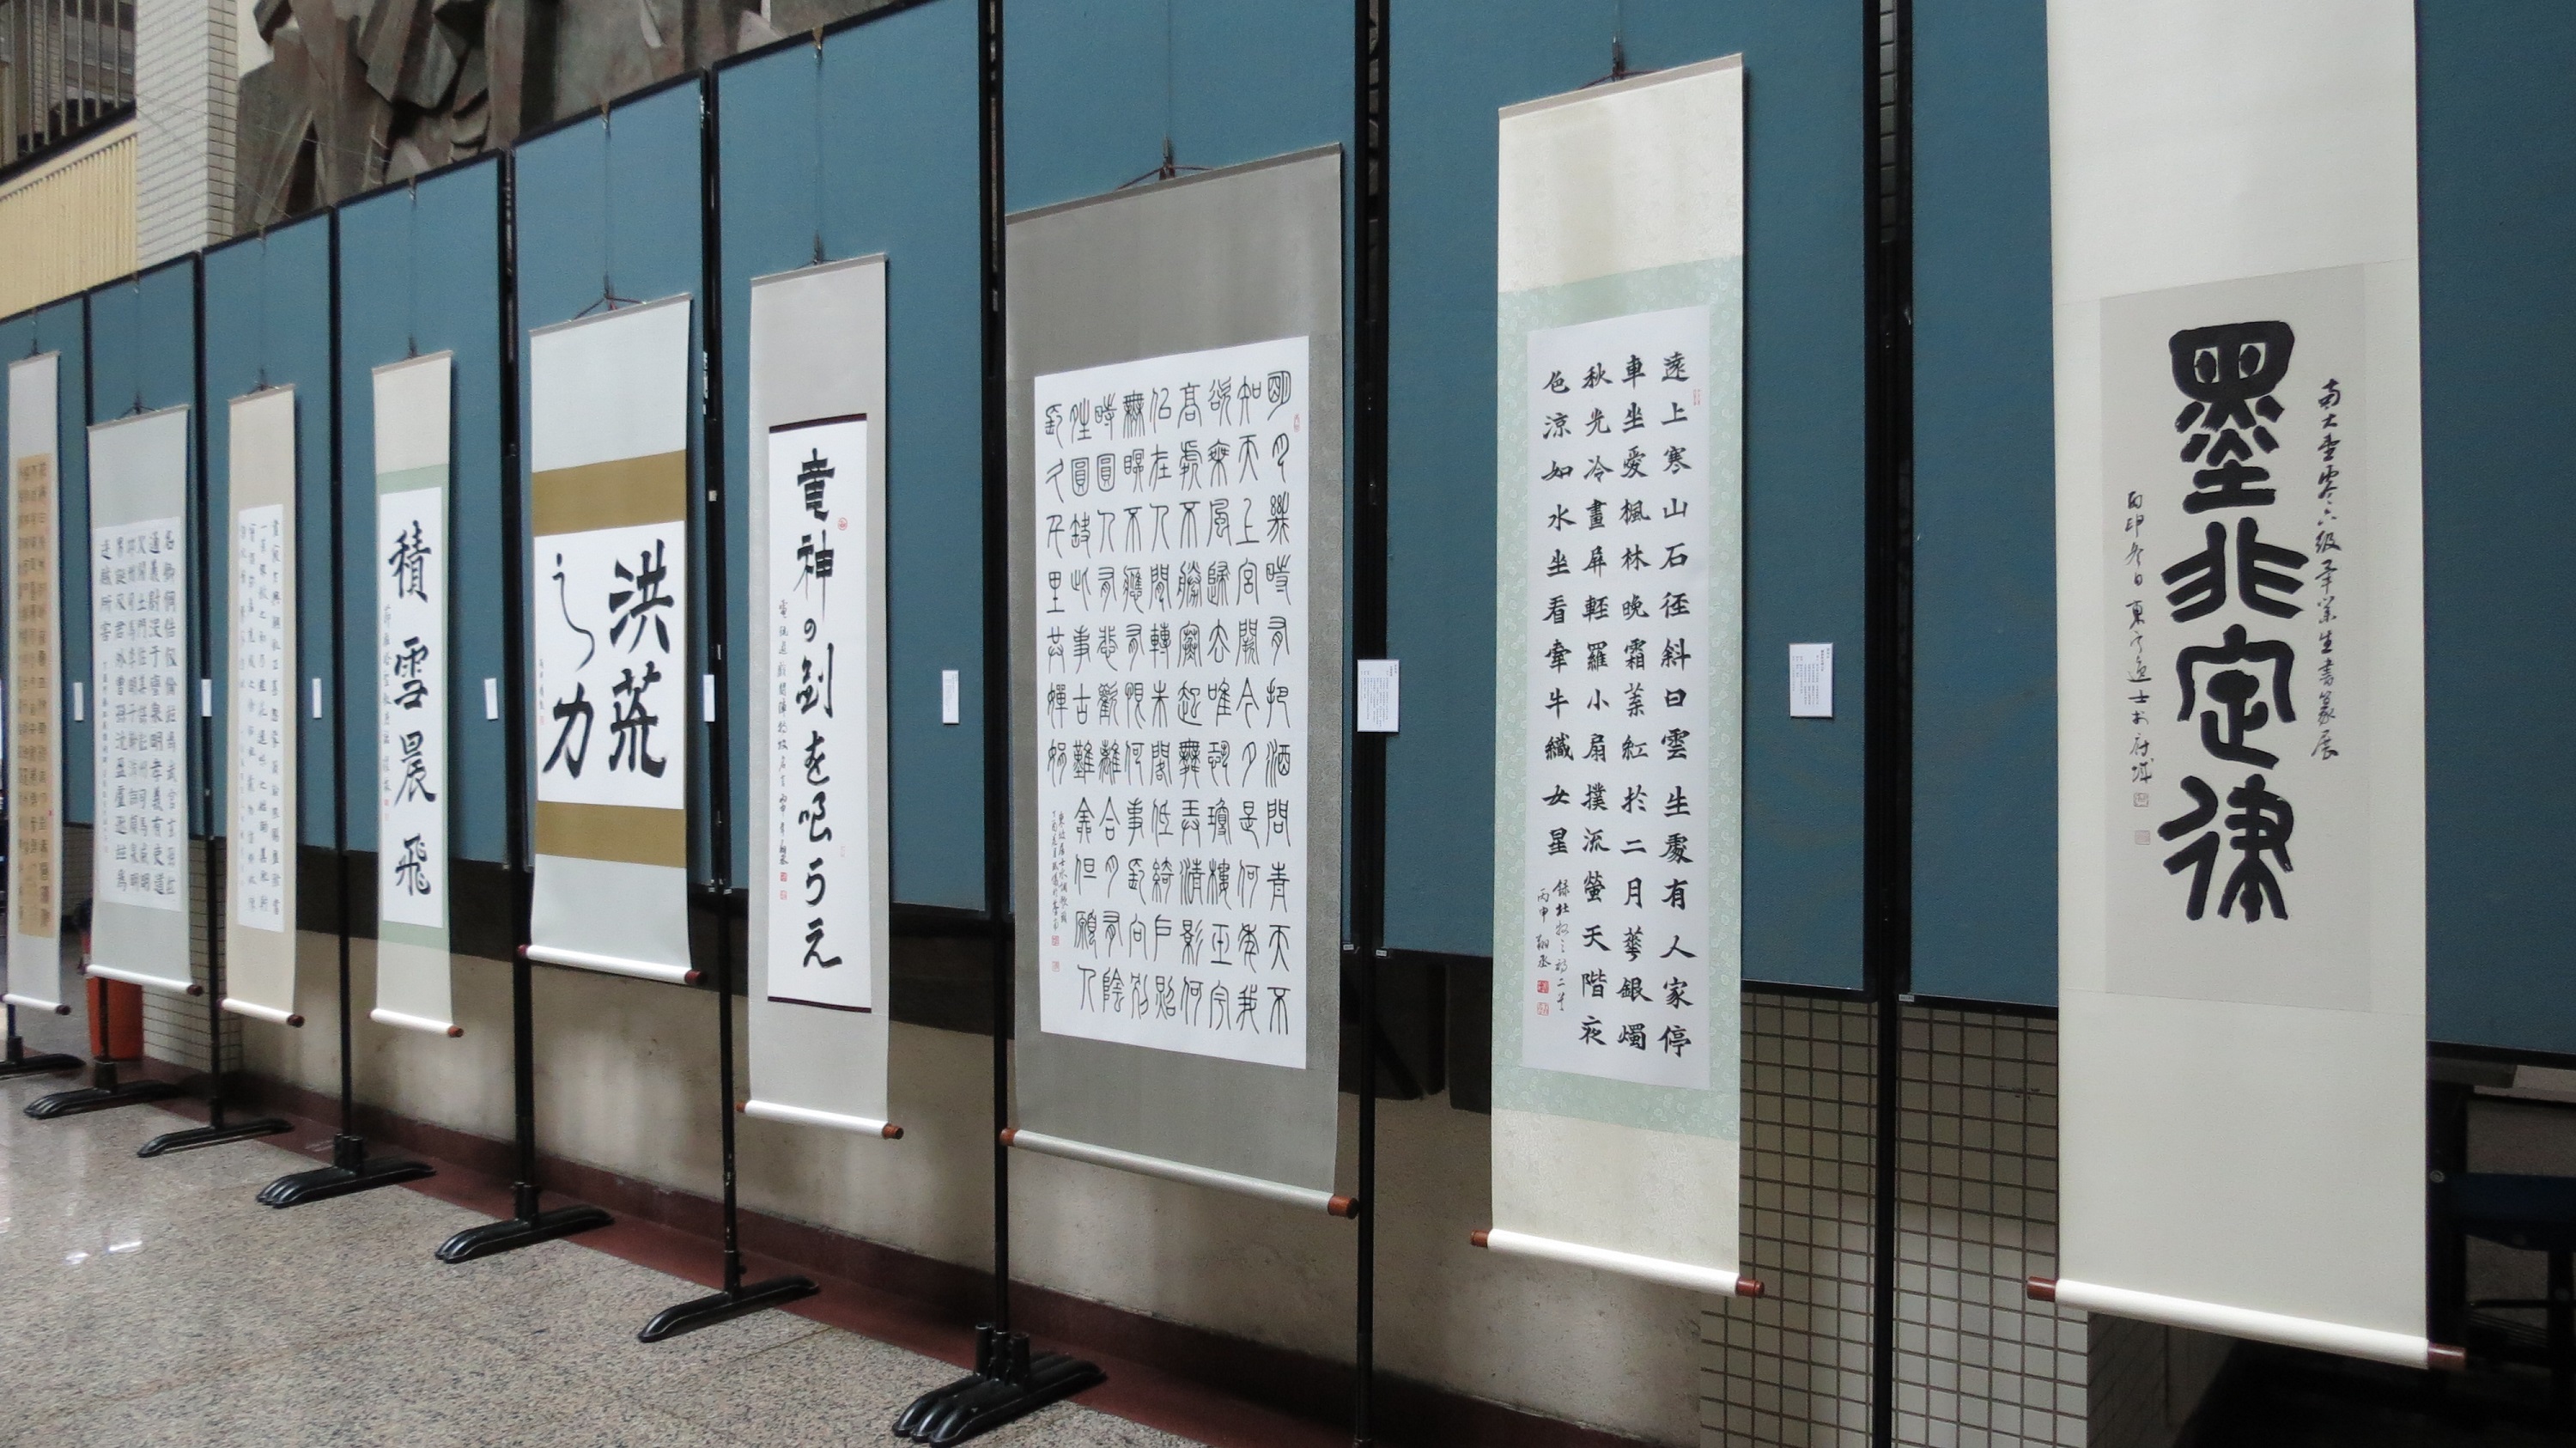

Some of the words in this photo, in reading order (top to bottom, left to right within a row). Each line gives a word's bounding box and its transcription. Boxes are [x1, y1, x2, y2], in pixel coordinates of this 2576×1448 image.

[608, 538, 675, 779] 洪荒
[2157, 320, 2310, 923] 墨非定律
